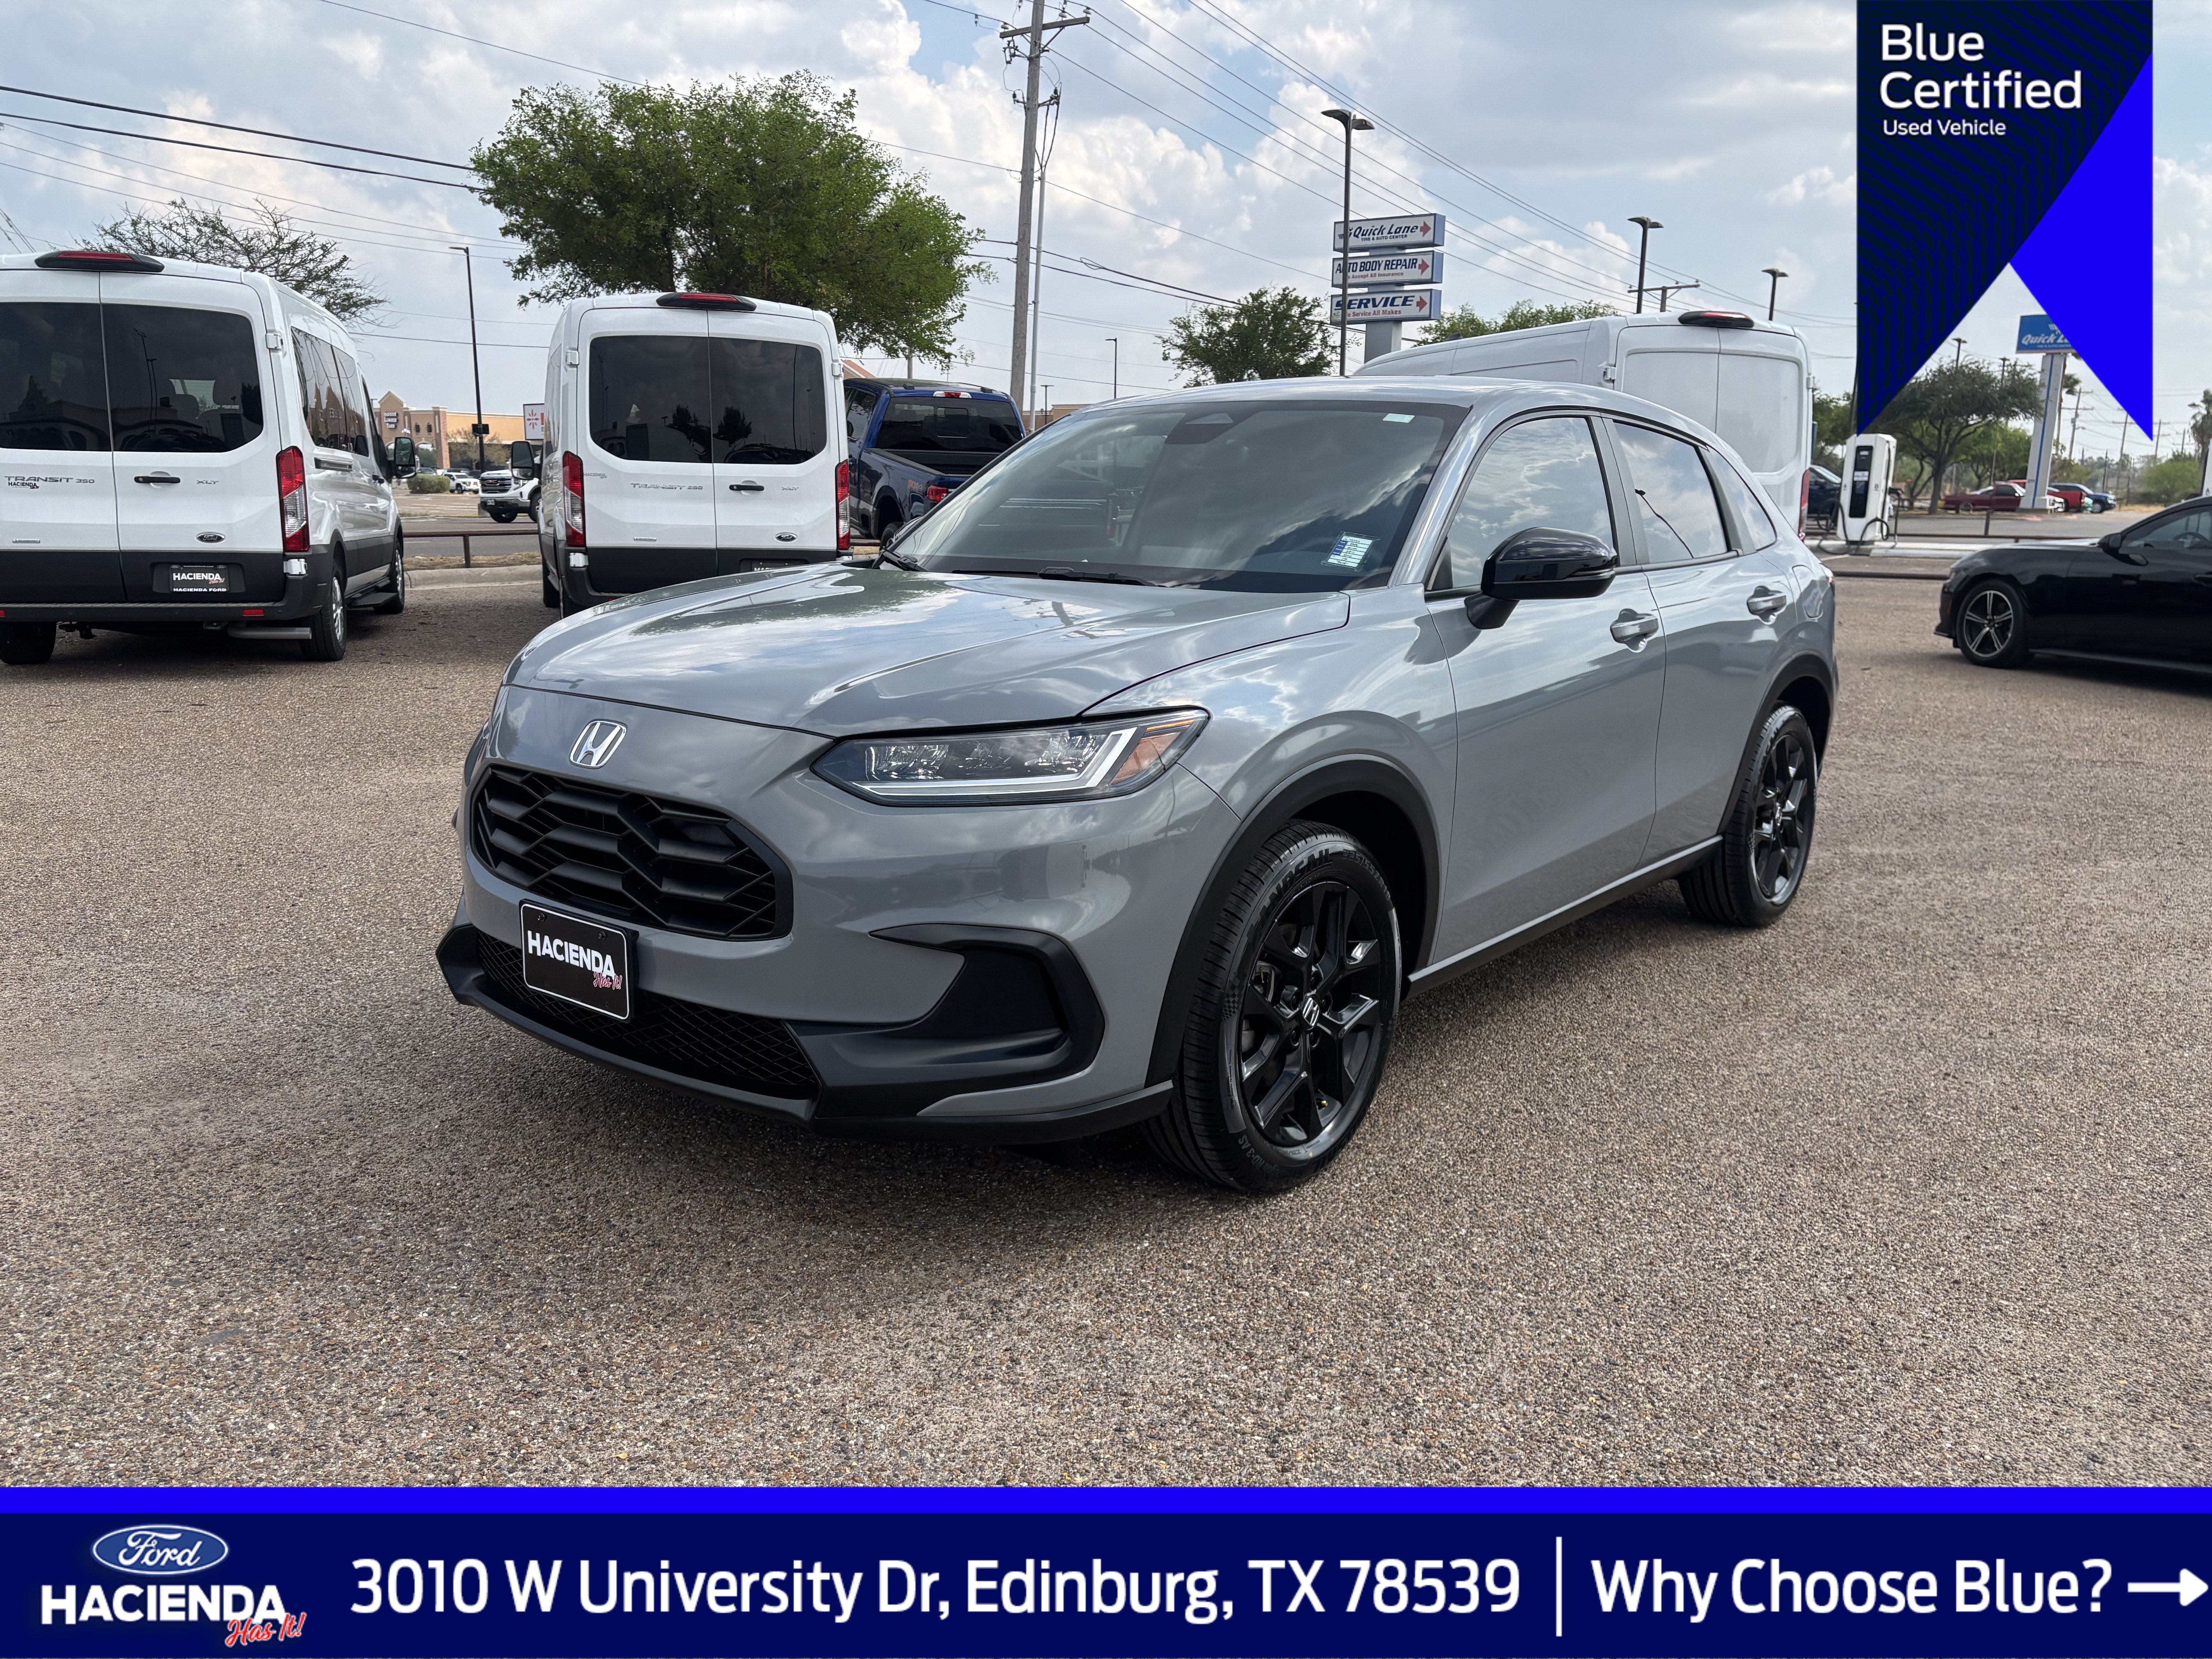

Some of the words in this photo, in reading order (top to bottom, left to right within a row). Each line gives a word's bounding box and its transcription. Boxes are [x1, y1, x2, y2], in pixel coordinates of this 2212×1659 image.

[1353, 225, 1386, 238] Quick
[1387, 224, 1419, 235] Lane
[1335, 262, 1358, 274] ATO
[1359, 260, 1383, 272] BODY
[1384, 258, 1418, 270] REPAIR
[1334, 295, 1415, 310] SERVICE
[2021, 333, 2057, 345] Quick
[527, 930, 615, 980] HACIENDA
[593, 971, 612, 988] Has
[612, 973, 622, 990] It!
